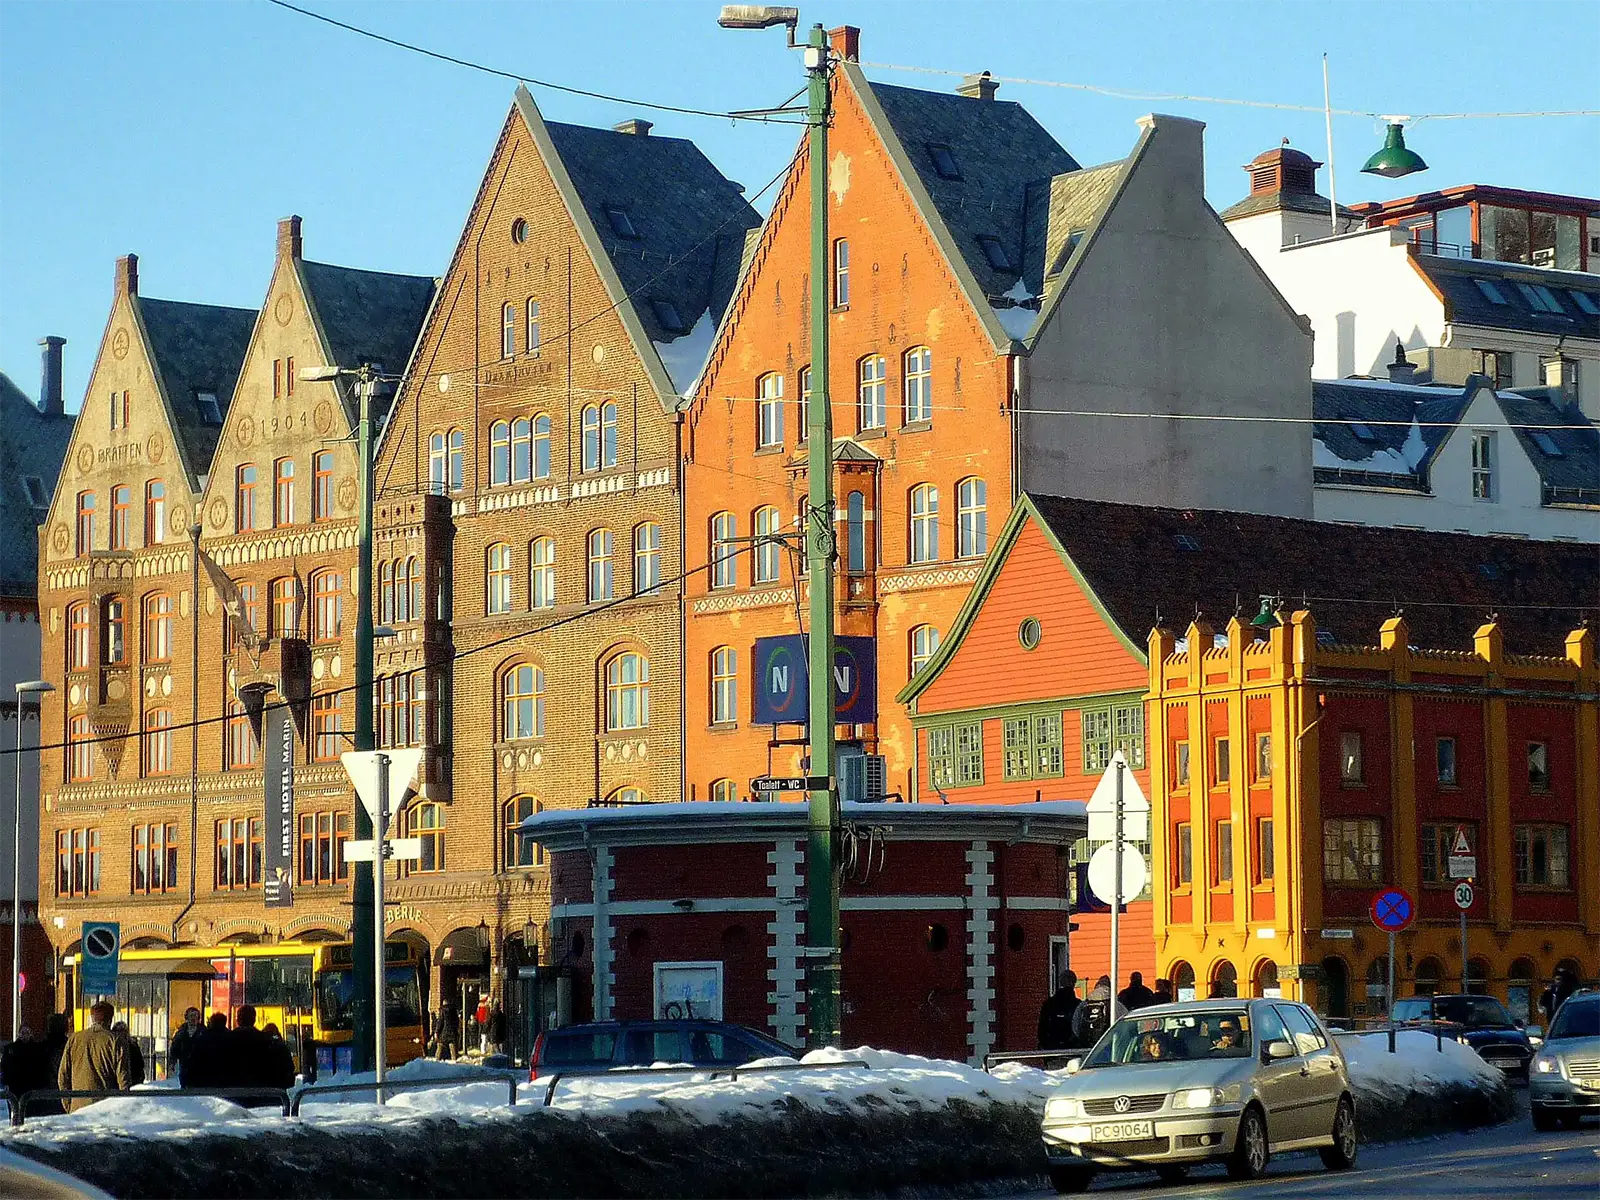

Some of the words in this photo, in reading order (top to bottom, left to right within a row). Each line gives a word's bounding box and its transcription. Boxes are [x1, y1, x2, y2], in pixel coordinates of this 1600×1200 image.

[262, 411, 307, 437] 1904
[98, 442, 142, 463] BRATTEN
[772, 665, 788, 693] N
[283, 718, 291, 763] MARIN
[282, 767, 290, 814] HOTEL
[757, 780, 780, 790] Toalett
[787, 780, 800, 789] WC
[282, 819, 290, 857] FIRST
[1456, 887, 1472, 903] 30
